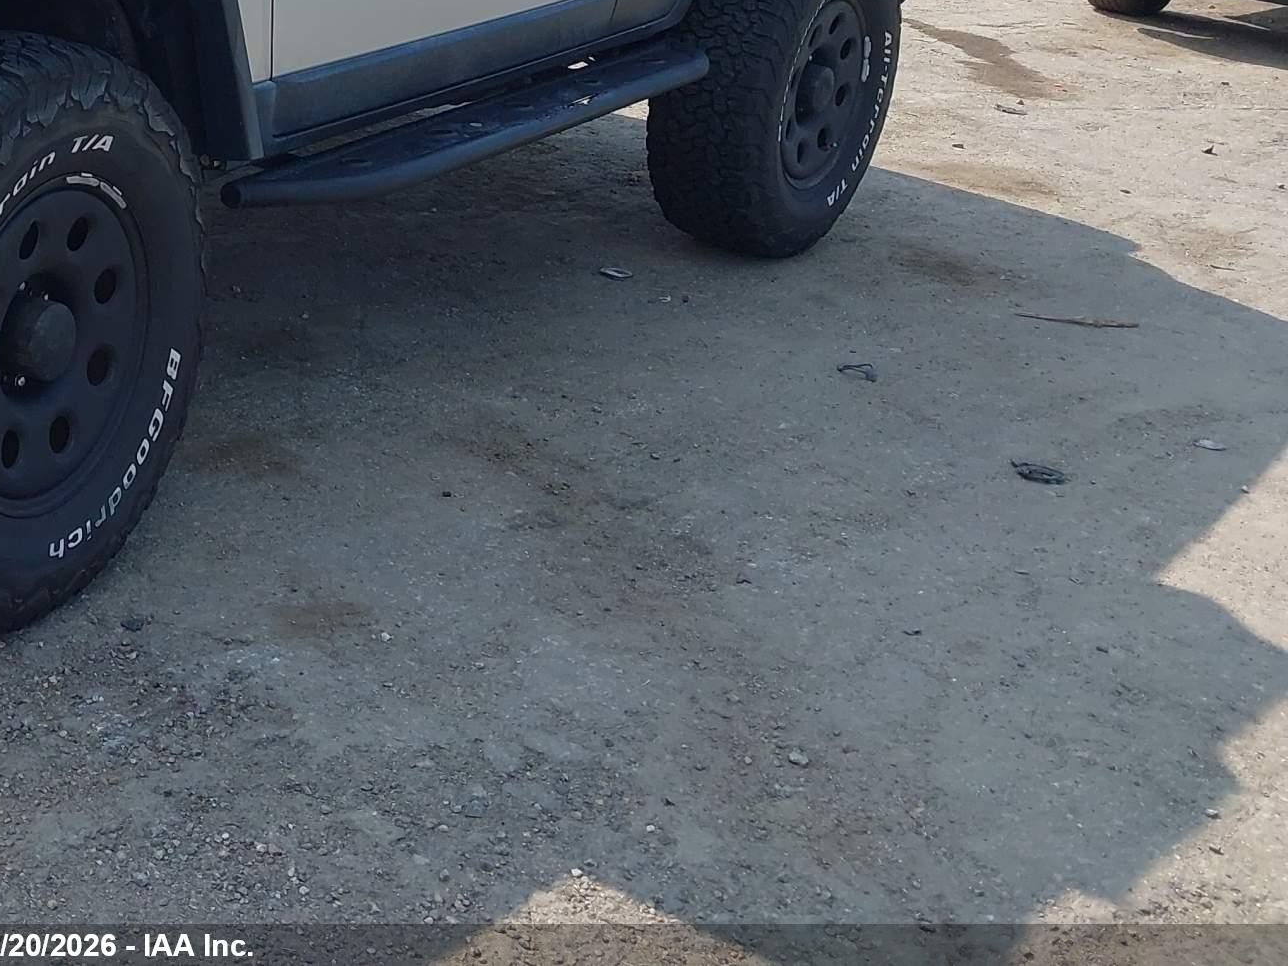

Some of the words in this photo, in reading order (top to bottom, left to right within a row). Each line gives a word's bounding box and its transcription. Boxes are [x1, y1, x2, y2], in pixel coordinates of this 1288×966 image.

[71, 134, 113, 153] T/A
[826, 179, 848, 207] T/A
[49, 348, 181, 558] BFGoodrich
